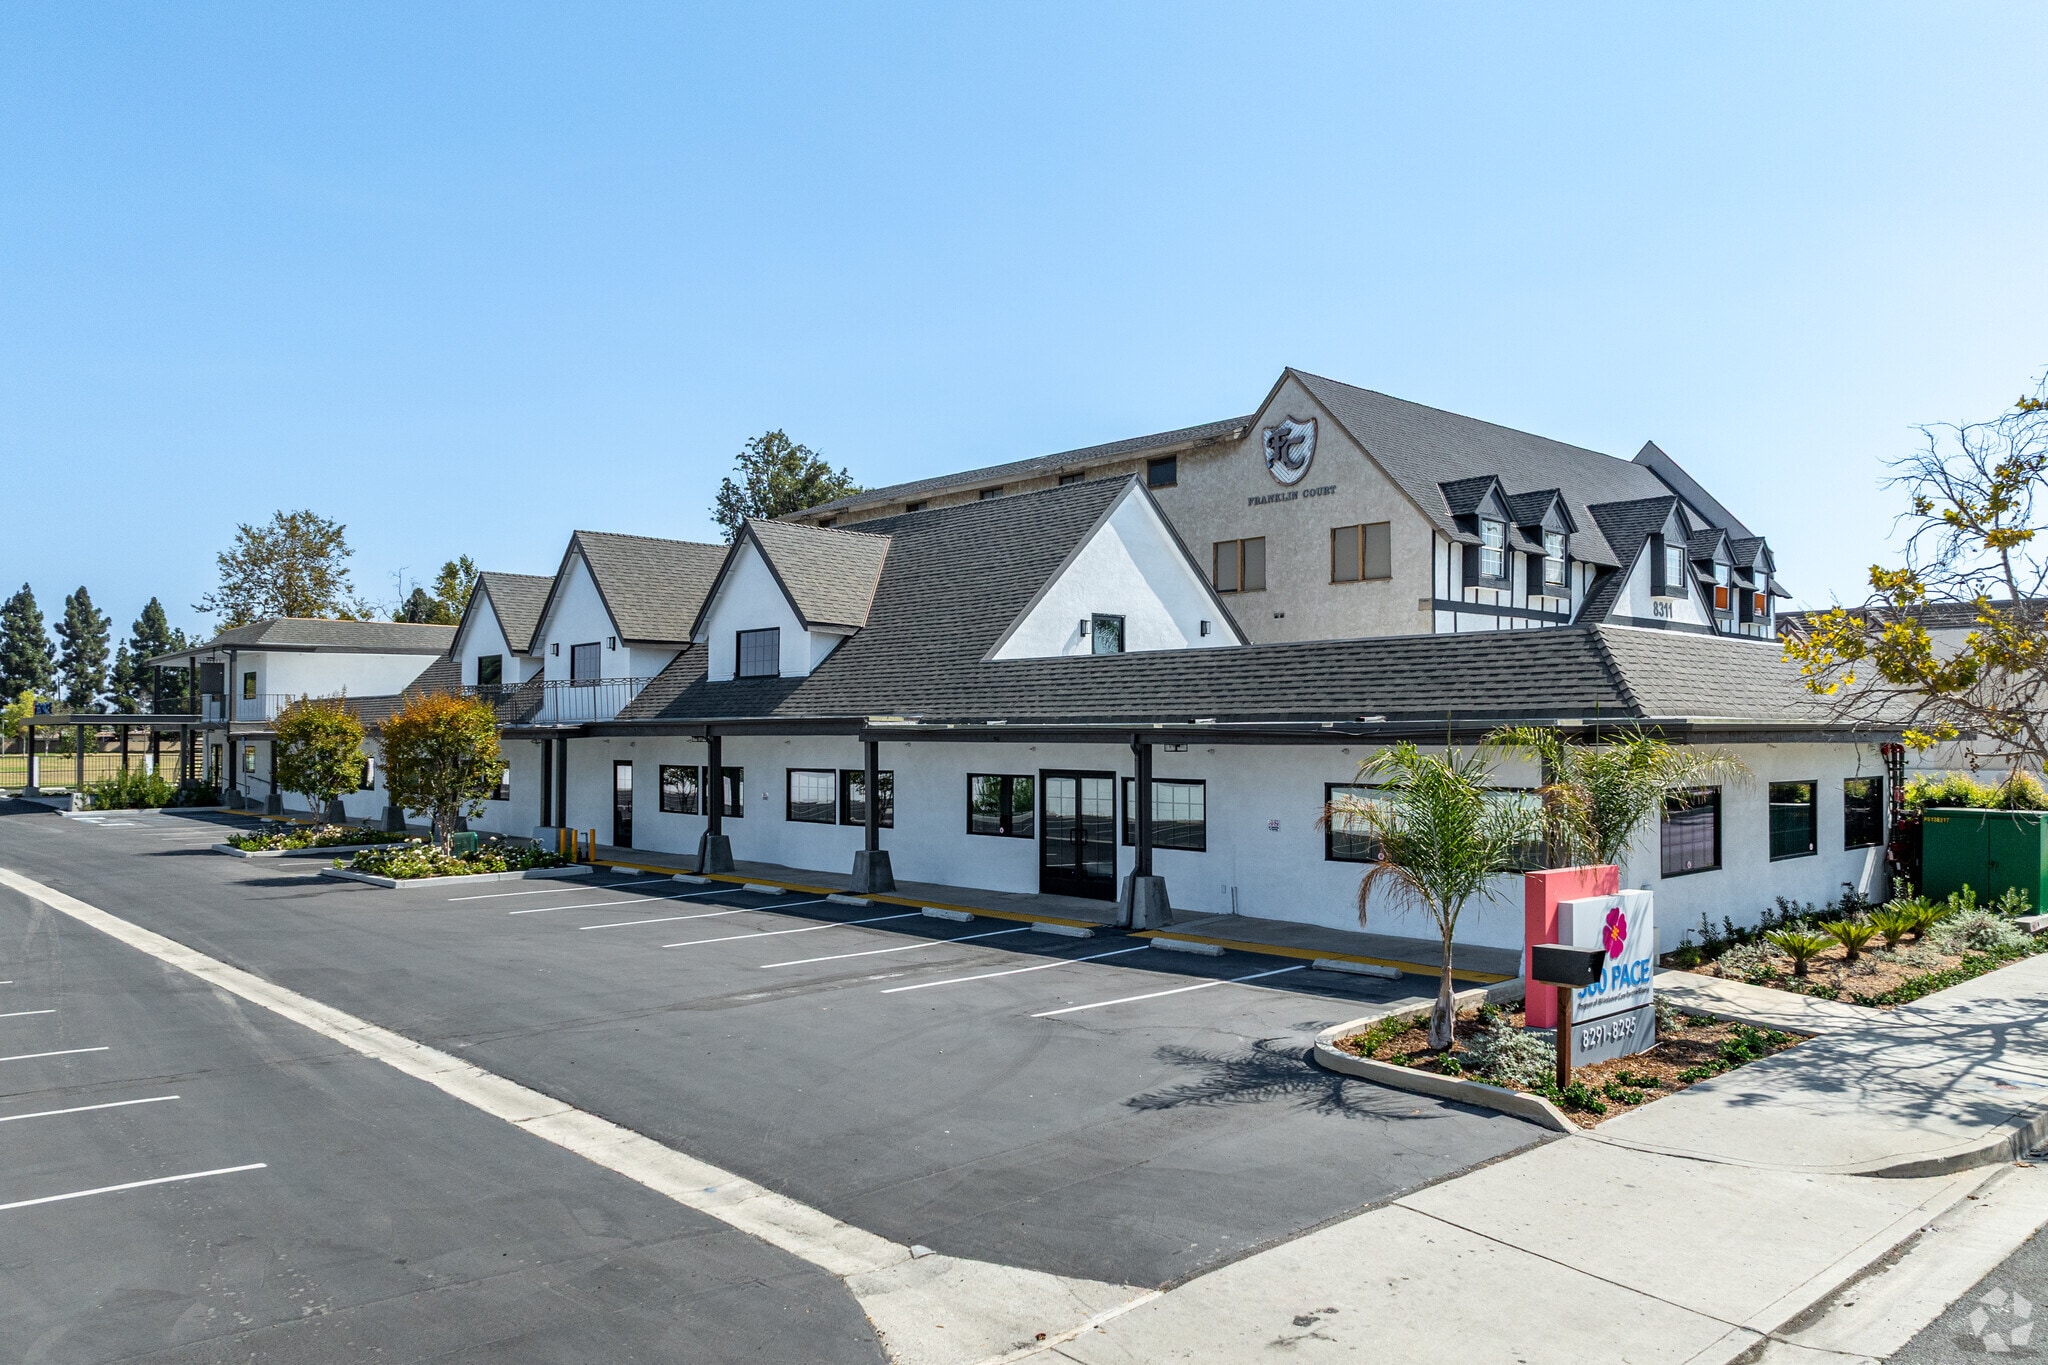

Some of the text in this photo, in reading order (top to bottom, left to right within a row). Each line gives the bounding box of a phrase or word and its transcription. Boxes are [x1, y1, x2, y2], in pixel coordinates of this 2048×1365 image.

[1248, 485, 1337, 507] FRANKLIN COURT
[1653, 601, 1673, 618] 8311
[1612, 958, 1650, 991] PACE
[1582, 1016, 1637, 1048] 8291-8295
